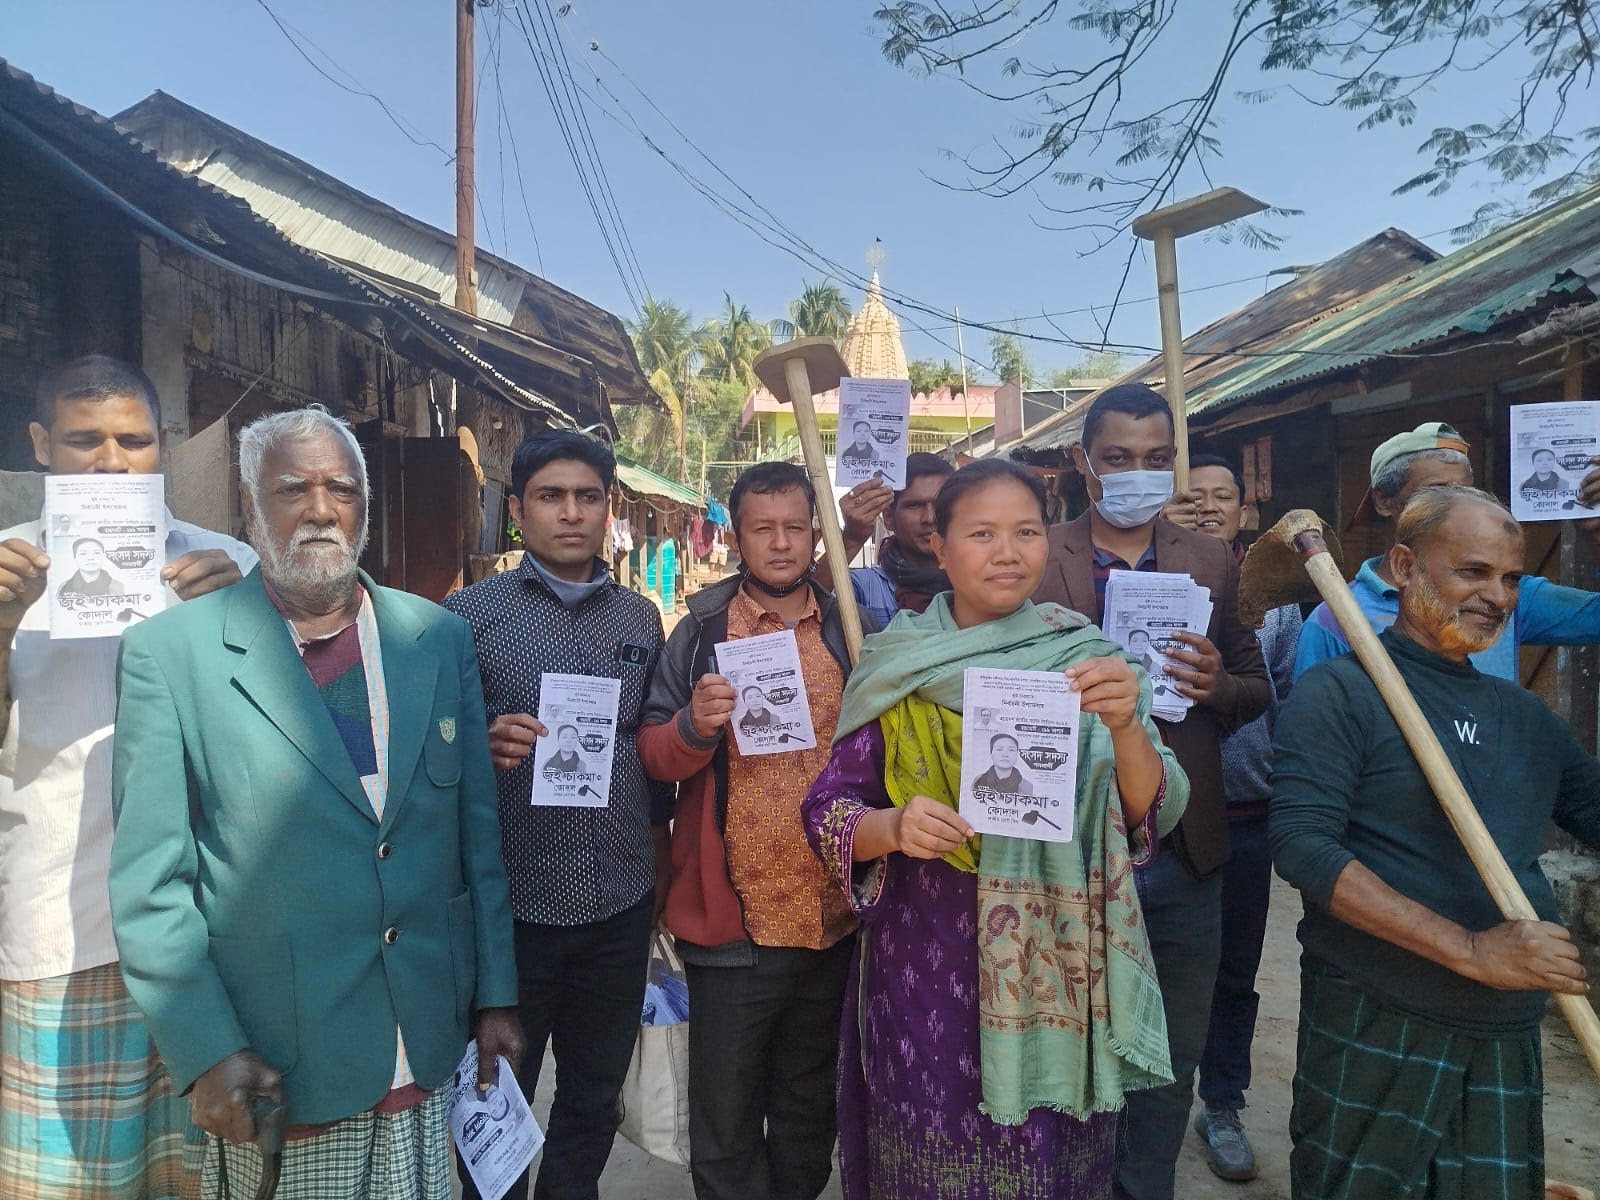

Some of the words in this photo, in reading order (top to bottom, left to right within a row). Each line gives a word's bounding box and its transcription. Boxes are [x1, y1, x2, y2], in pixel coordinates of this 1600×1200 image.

[106, 550, 131, 562] সংসদ
[58, 592, 88, 611] জুঁই
[93, 592, 142, 607] চাকমা
[78, 610, 113, 620] কোদাল
[1019, 749, 1043, 762] সংসদ
[1044, 751, 1069, 764] সদস্য
[564, 771, 596, 783] চাকমা
[972, 786, 1000, 805] জুঁই
[1001, 791, 1049, 808] চাকমা
[987, 805, 1020, 818] কোদাল
